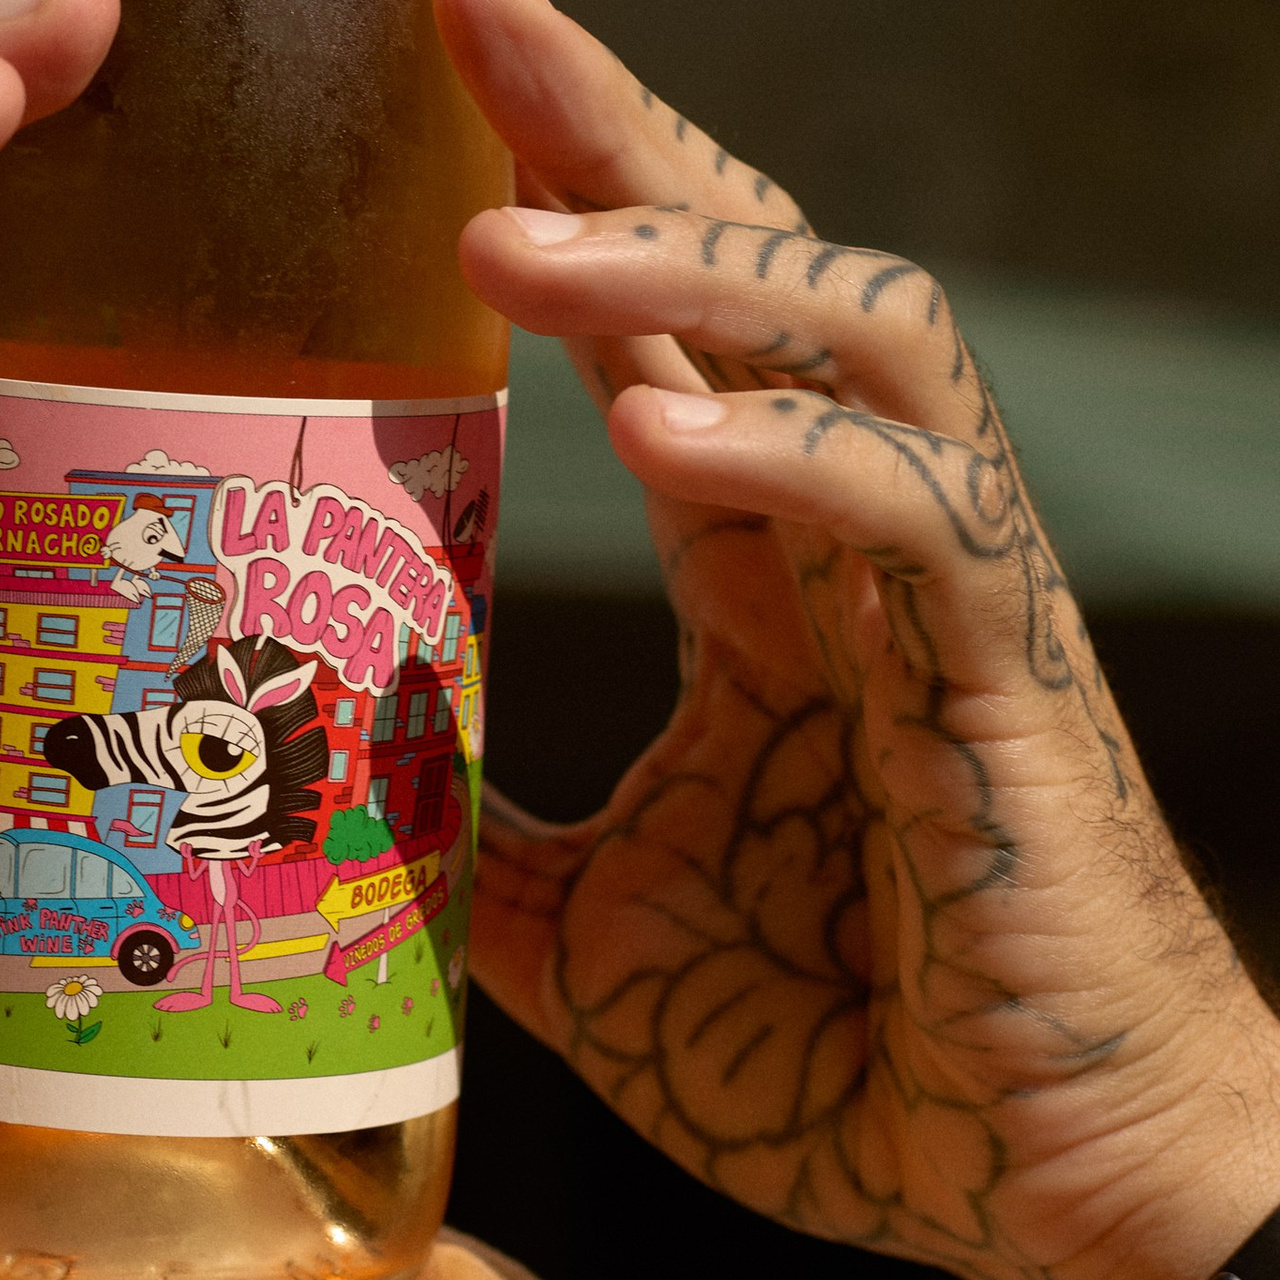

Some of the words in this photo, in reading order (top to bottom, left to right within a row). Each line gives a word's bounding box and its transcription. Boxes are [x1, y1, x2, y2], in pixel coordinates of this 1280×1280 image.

[14, 500, 111, 530] ROSADO
[221, 486, 290, 556] LA
[302, 496, 446, 638] PANTERA
[240, 557, 396, 689] ROSA
[351, 865, 428, 909] BODEGA
[39, 908, 109, 942] PANTHER
[388, 922, 403, 942] DE
